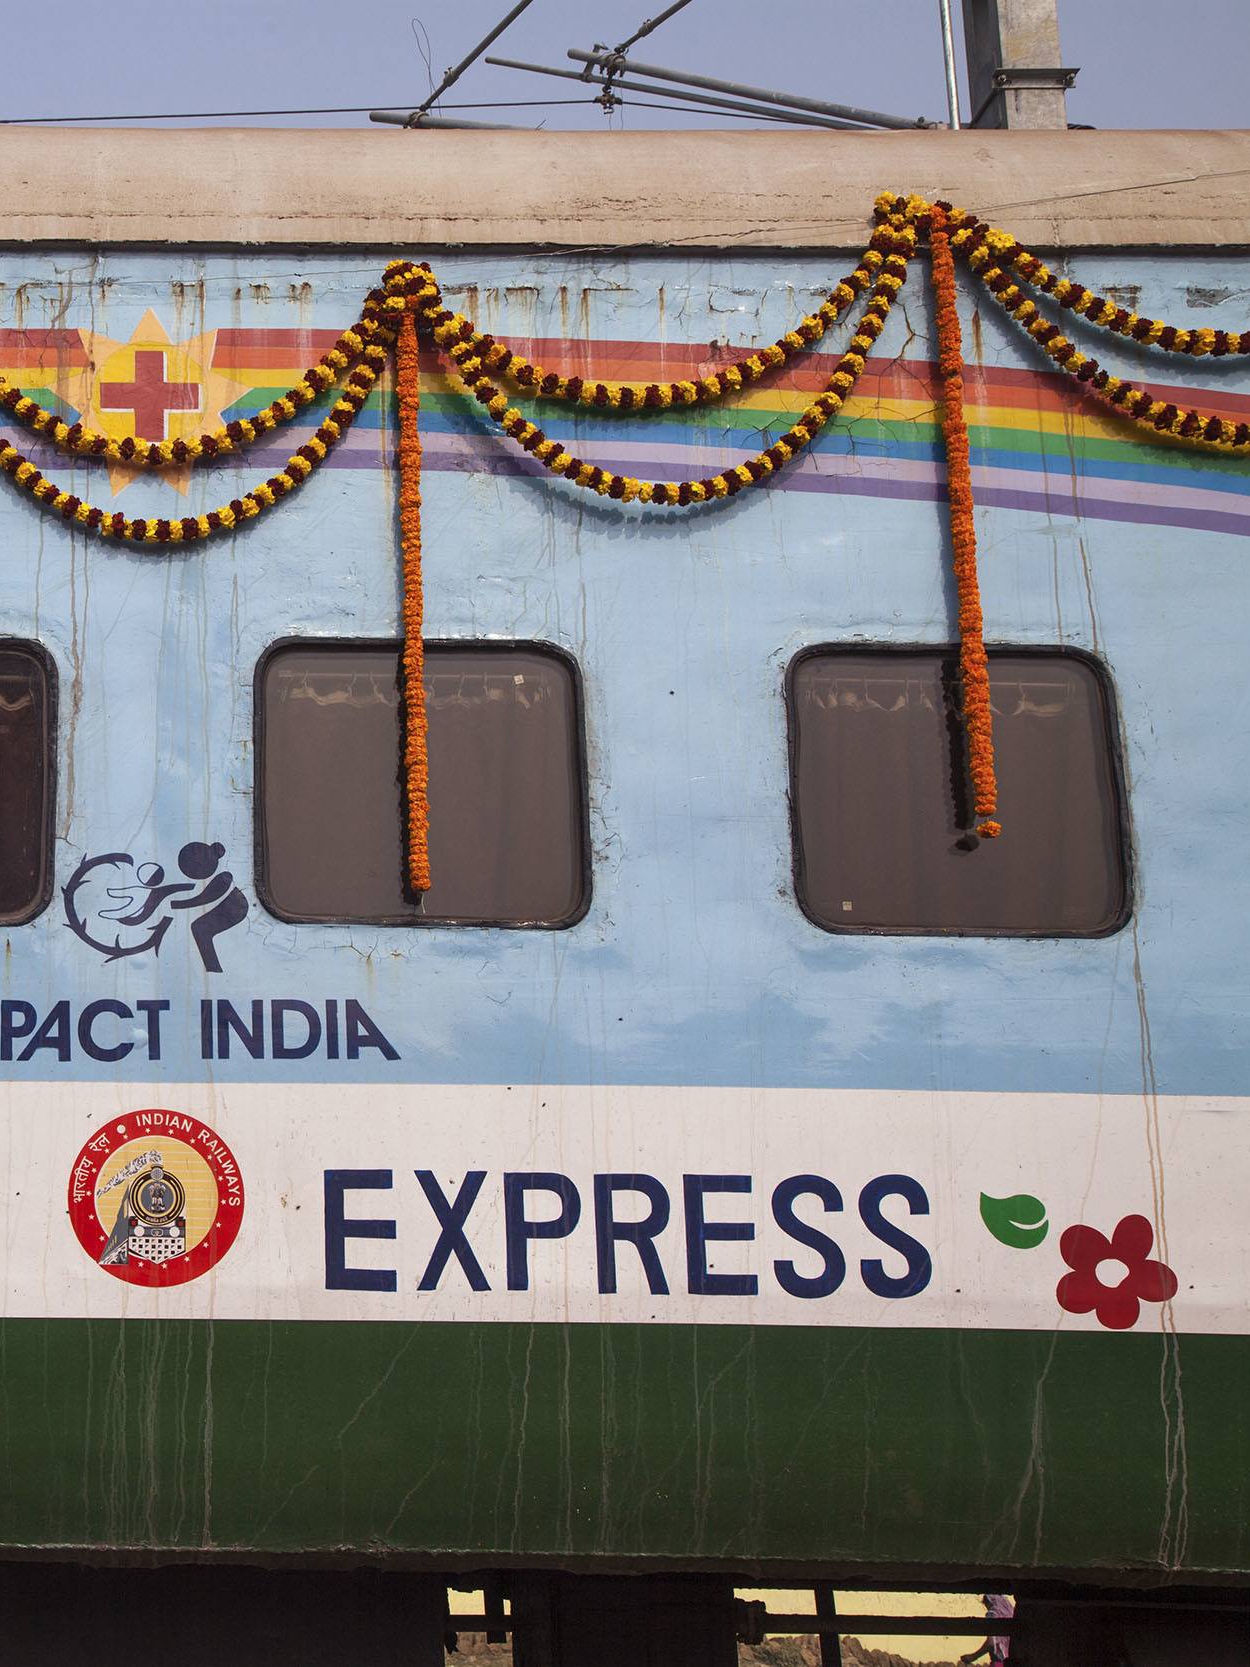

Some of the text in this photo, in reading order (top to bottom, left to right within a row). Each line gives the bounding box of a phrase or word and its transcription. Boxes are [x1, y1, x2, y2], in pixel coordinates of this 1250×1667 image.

[201, 999, 401, 1061] INDIA
[74, 1132, 110, 1204] भारतीय रेल
[136, 1113, 241, 1207] INDIAN RAILWAYS
[324, 1169, 932, 1299] EXPRESS
